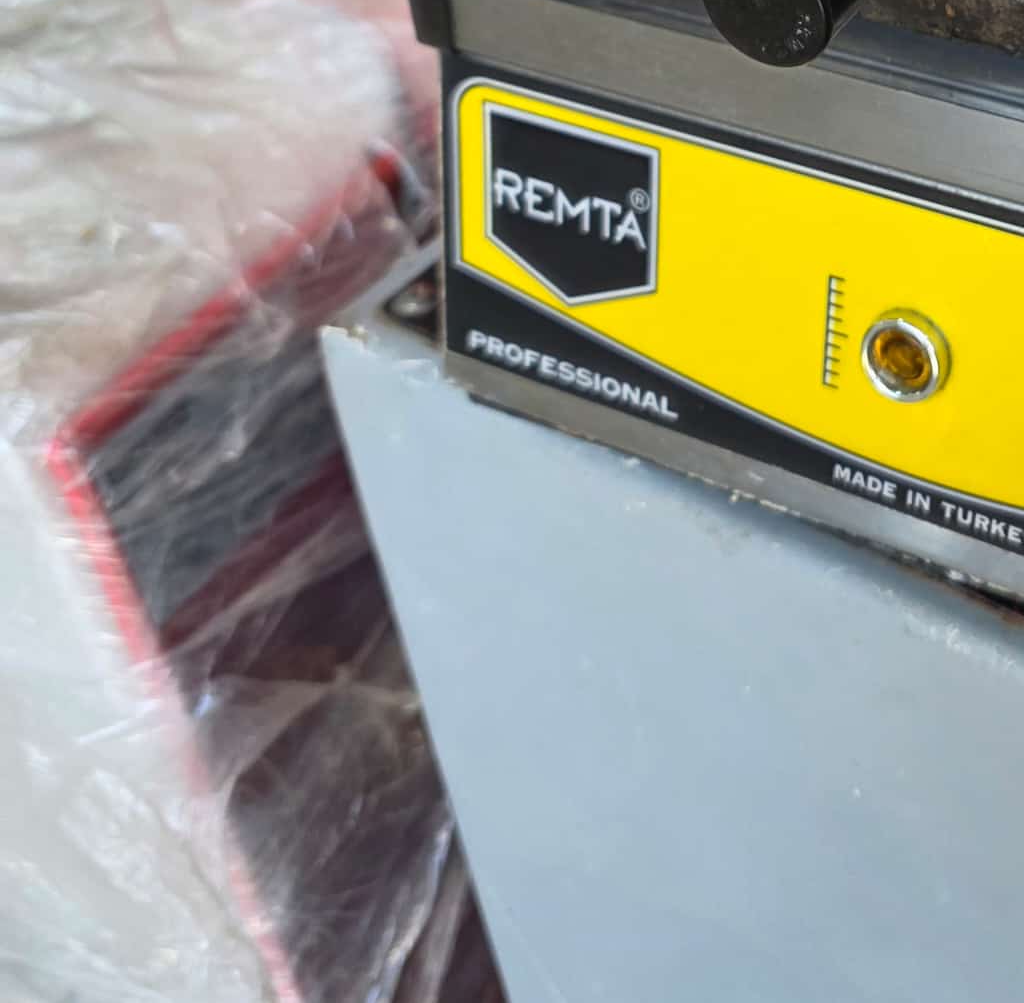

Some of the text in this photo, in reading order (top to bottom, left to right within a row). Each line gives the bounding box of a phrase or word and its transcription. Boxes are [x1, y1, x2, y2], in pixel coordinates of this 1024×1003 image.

[467, 329, 679, 420] PROFESSIONAL
[833, 464, 897, 498] MADE
[906, 489, 931, 512] IN
